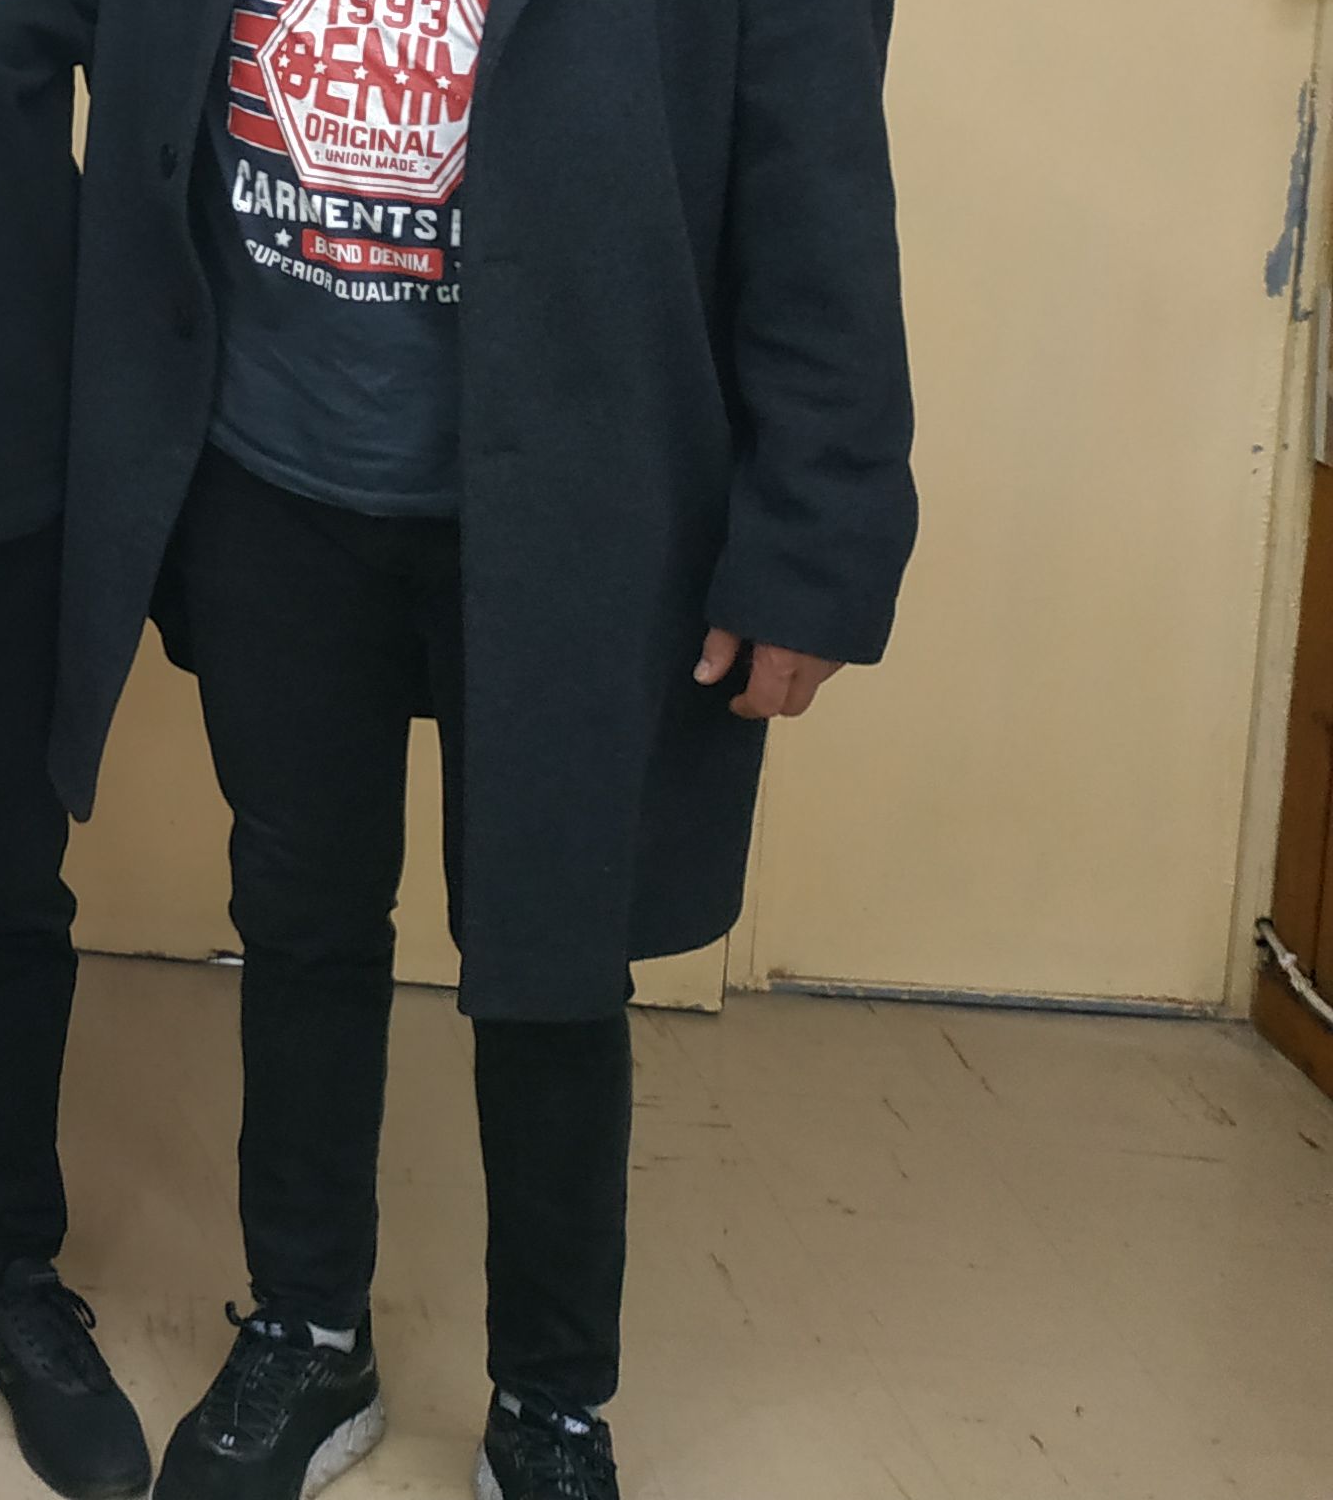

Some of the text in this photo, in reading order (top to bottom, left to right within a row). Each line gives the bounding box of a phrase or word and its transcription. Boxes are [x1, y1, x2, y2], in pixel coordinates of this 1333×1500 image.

[304, 112, 445, 159] ORIGINAL
[325, 148, 418, 172] UNION MADE
[335, 279, 429, 303] QUALITY
